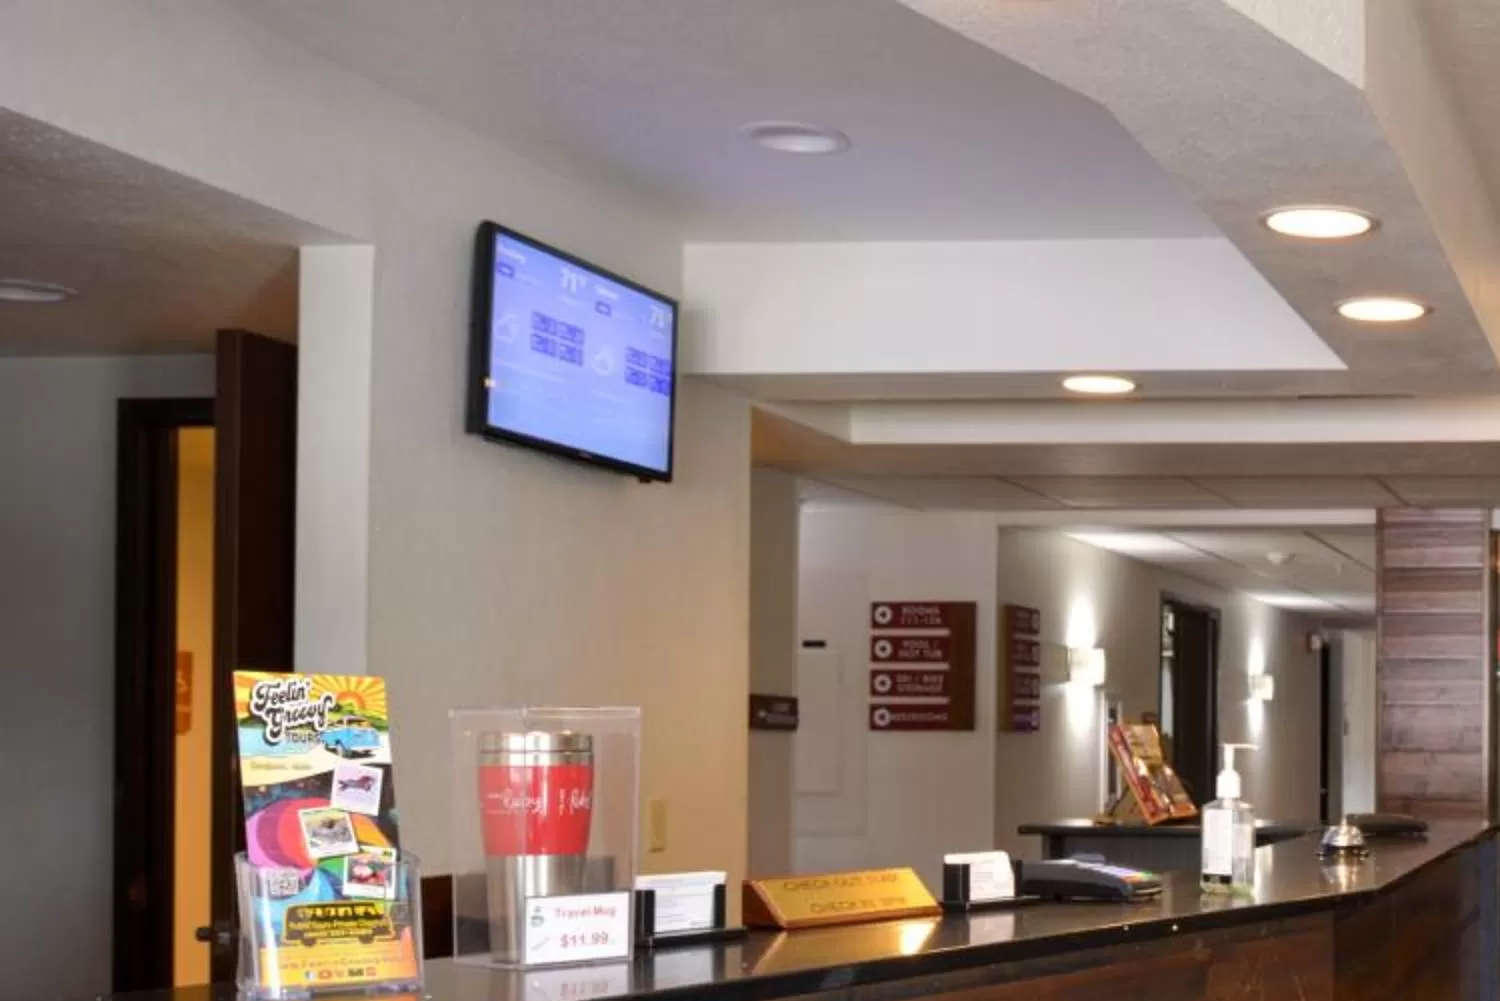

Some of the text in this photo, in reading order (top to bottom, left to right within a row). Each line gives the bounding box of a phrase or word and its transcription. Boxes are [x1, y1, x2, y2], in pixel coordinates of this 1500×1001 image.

[253, 679, 311, 712] Feelin'
[263, 694, 335, 740] Groovy
[284, 730, 323, 744] TOURS
[554, 903, 617, 919] Travel Mug
[559, 930, 609, 949] $11.99
